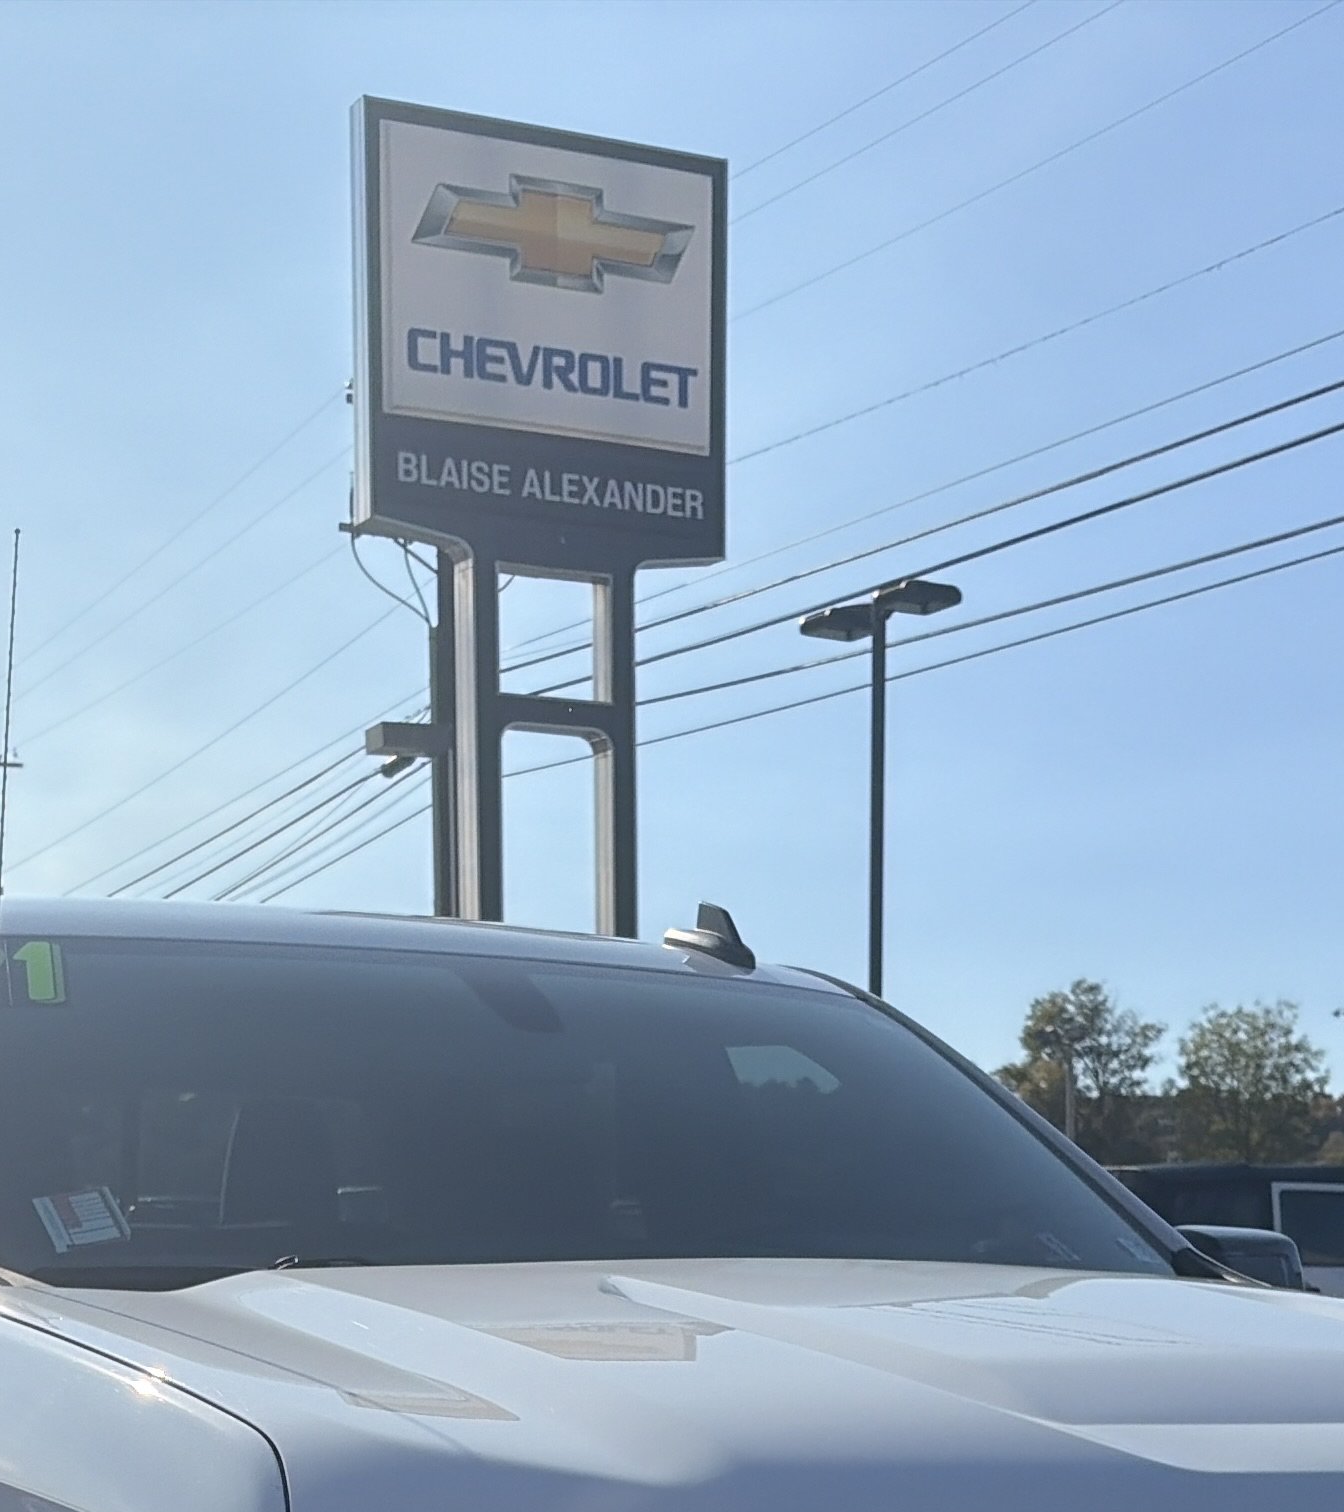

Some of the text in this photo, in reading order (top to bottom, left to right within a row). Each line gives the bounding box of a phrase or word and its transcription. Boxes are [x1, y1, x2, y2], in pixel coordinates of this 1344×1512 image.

[407, 327, 698, 408] CHEVROLET
[397, 452, 704, 520] BLAISE ALEXANDER
